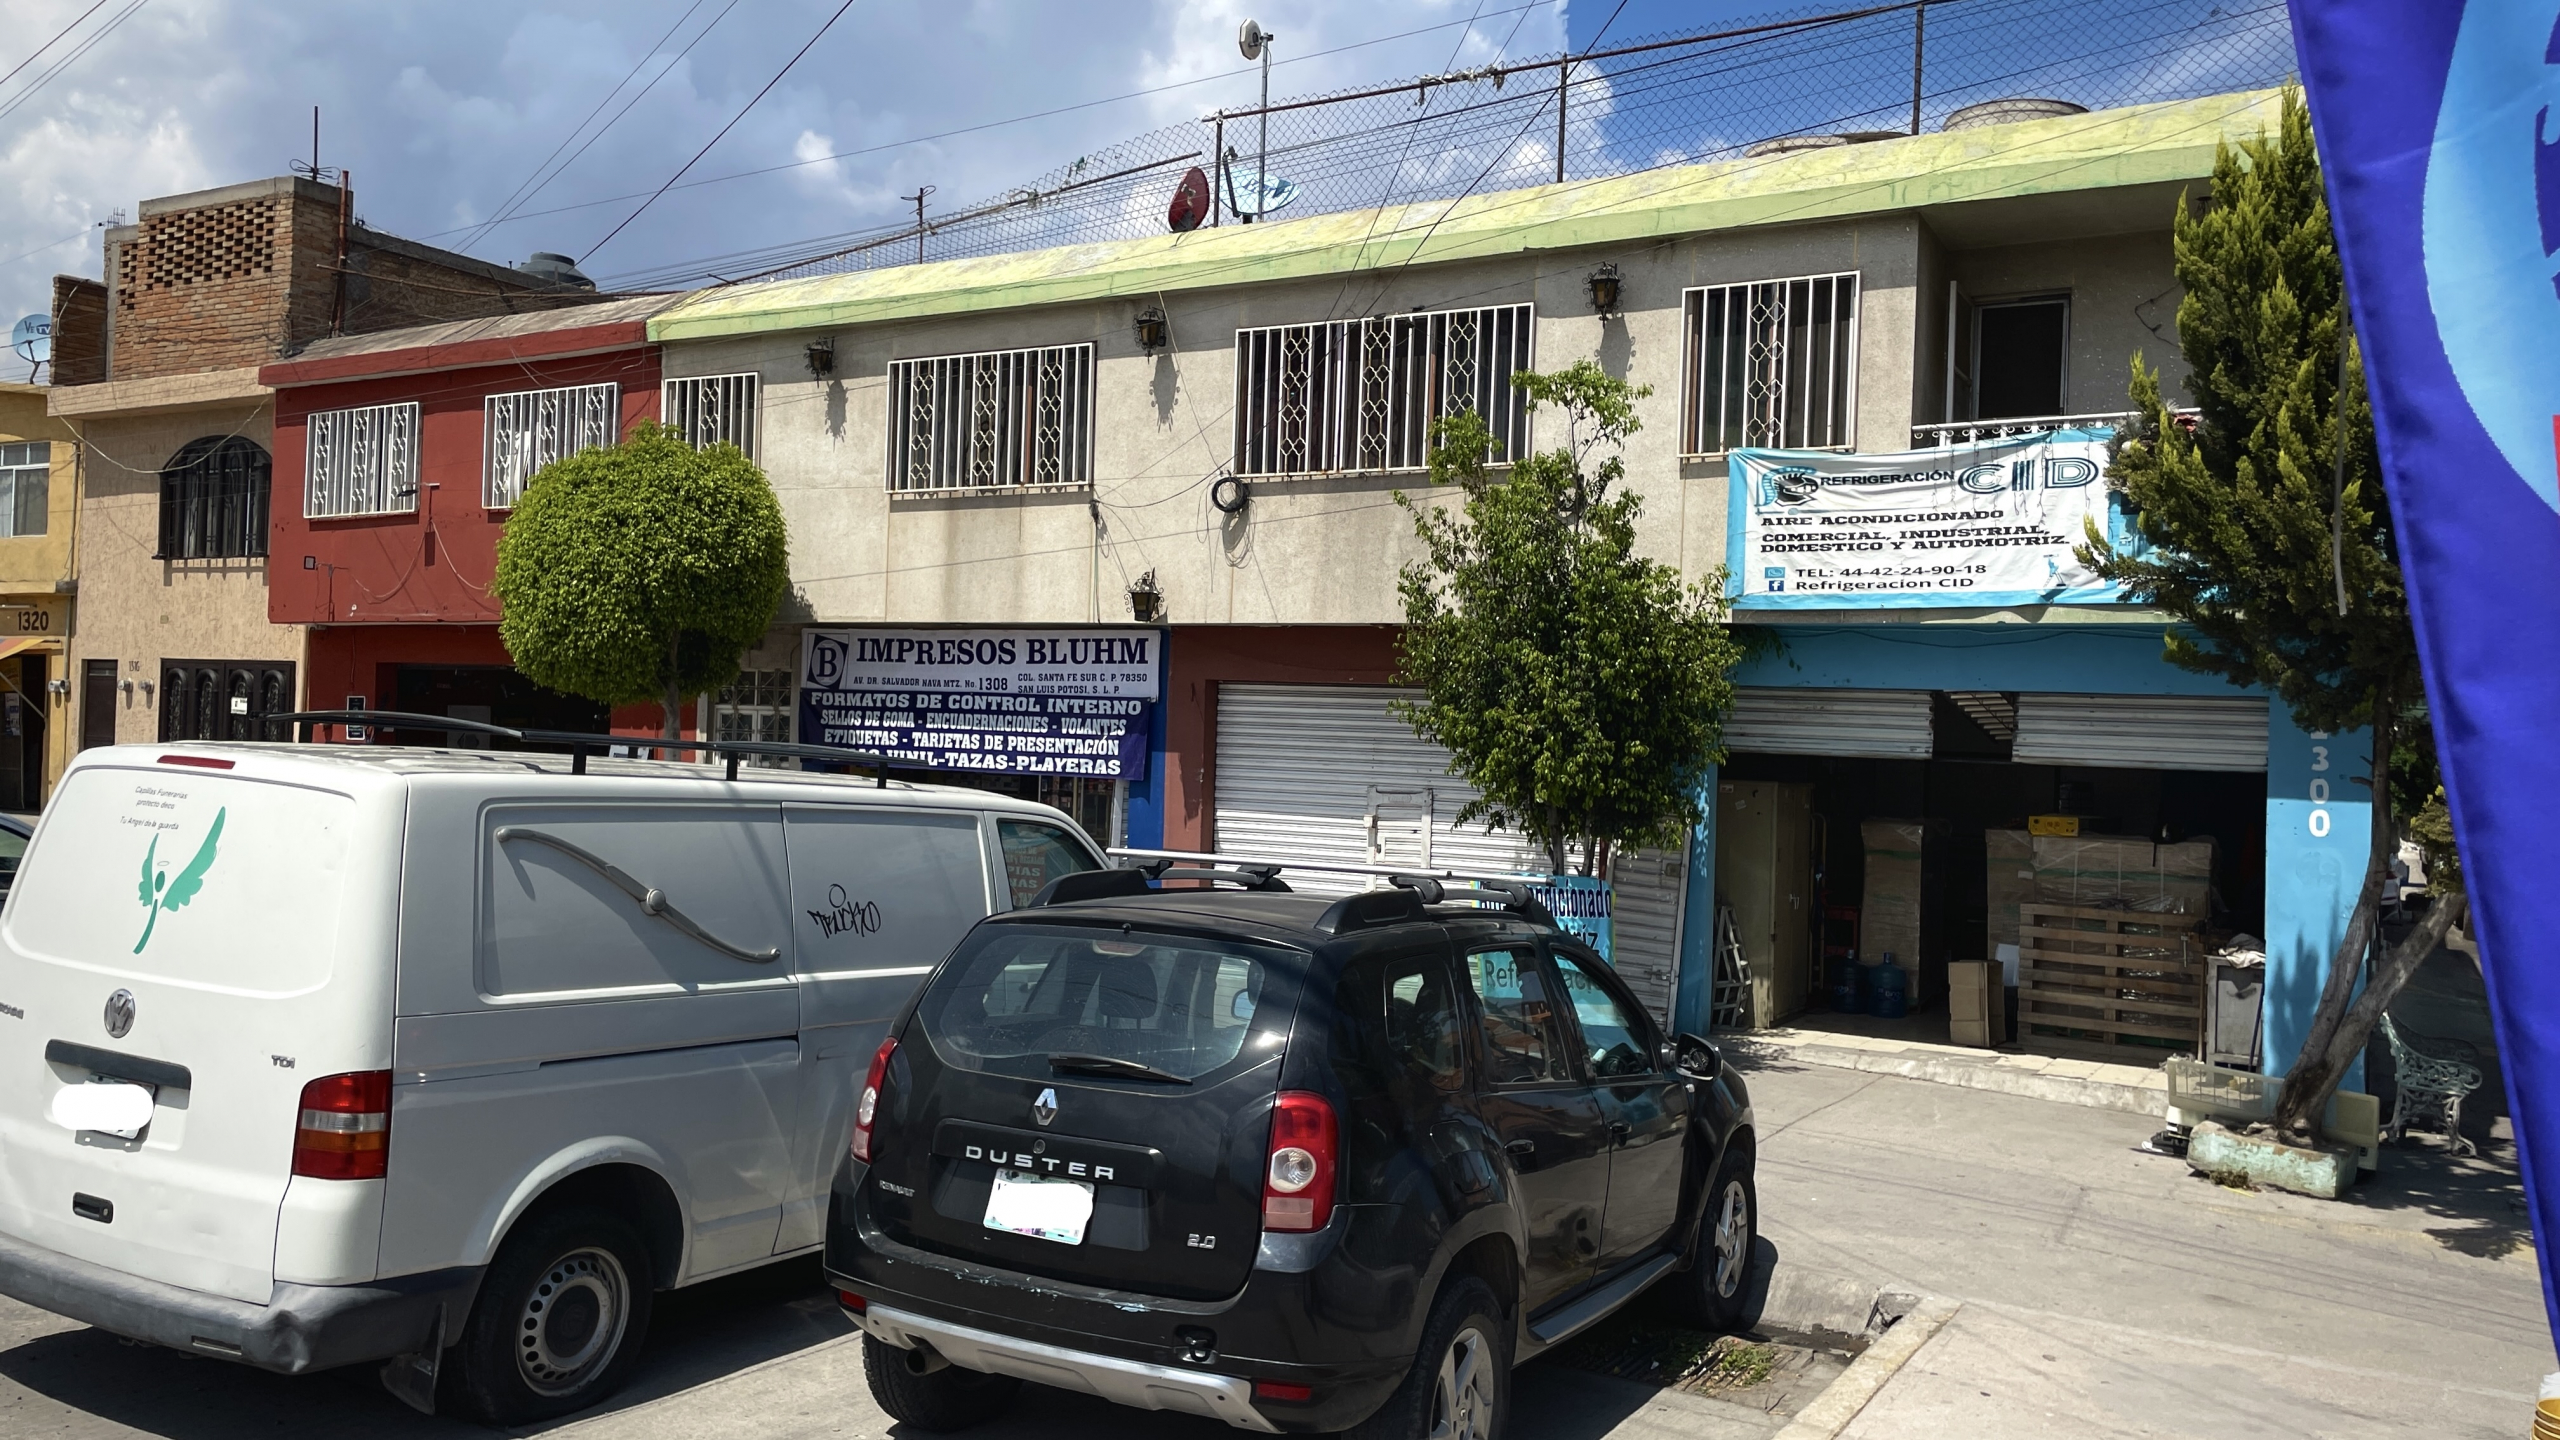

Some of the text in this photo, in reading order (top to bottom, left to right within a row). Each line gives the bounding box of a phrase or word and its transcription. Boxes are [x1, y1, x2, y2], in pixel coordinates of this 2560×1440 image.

[1820, 457, 2099, 494] REFRIGERACIÓN CID
[1761, 510, 2004, 526] AIRE ACONDICIONADO
[1762, 525, 2050, 542] COMERCIAL, INDUSTRIAL,
[1760, 542, 1883, 553] DOMESTICO
[1890, 541, 1906, 550] Y
[1796, 565, 1987, 578] TEL: 44-42-24-90-18
[1796, 579, 1931, 592] Refrigeracion
[1938, 578, 1974, 588] CID
[18, 611, 49, 631] 1320
[856, 638, 1149, 665] IMPRESOS BLUHM
[854, 677, 865, 685] AV.
[867, 677, 880, 685] DR.
[881, 677, 920, 687] SALVADOR
[922, 679, 942, 688] NAVA
[943, 680, 963, 688] MTZ.
[979, 678, 1008, 691] 1308
[1018, 673, 1036, 682] COL.
[1038, 673, 1065, 682] SANTA
[1067, 673, 1078, 682] FE
[1080, 673, 1097, 682] SUR
[1120, 673, 1148, 682] 78350
[1018, 685, 1034, 694] SAN
[1036, 685, 1055, 694] LUIS
[811, 692, 1142, 715] FORMATOS DE CONTROL INTERNO
[820, 710, 862, 726] SELLOS
[864, 711, 880, 727] DE
[925, 713, 1049, 733] ENCUADERNACIONES
[1061, 717, 1127, 736] VOLANTES
[824, 729, 899, 746] ETIQUETAS
[912, 731, 980, 749] TARJETAS
[984, 734, 1004, 751] DE
[1007, 736, 1119, 756] PRESENTACIÓN
[157, 788, 188, 800] Funerarias
[271, 1055, 296, 1069] TDI
[965, 1145, 1115, 1180] DUSTER
[1187, 1233, 1217, 1250] 2.0
